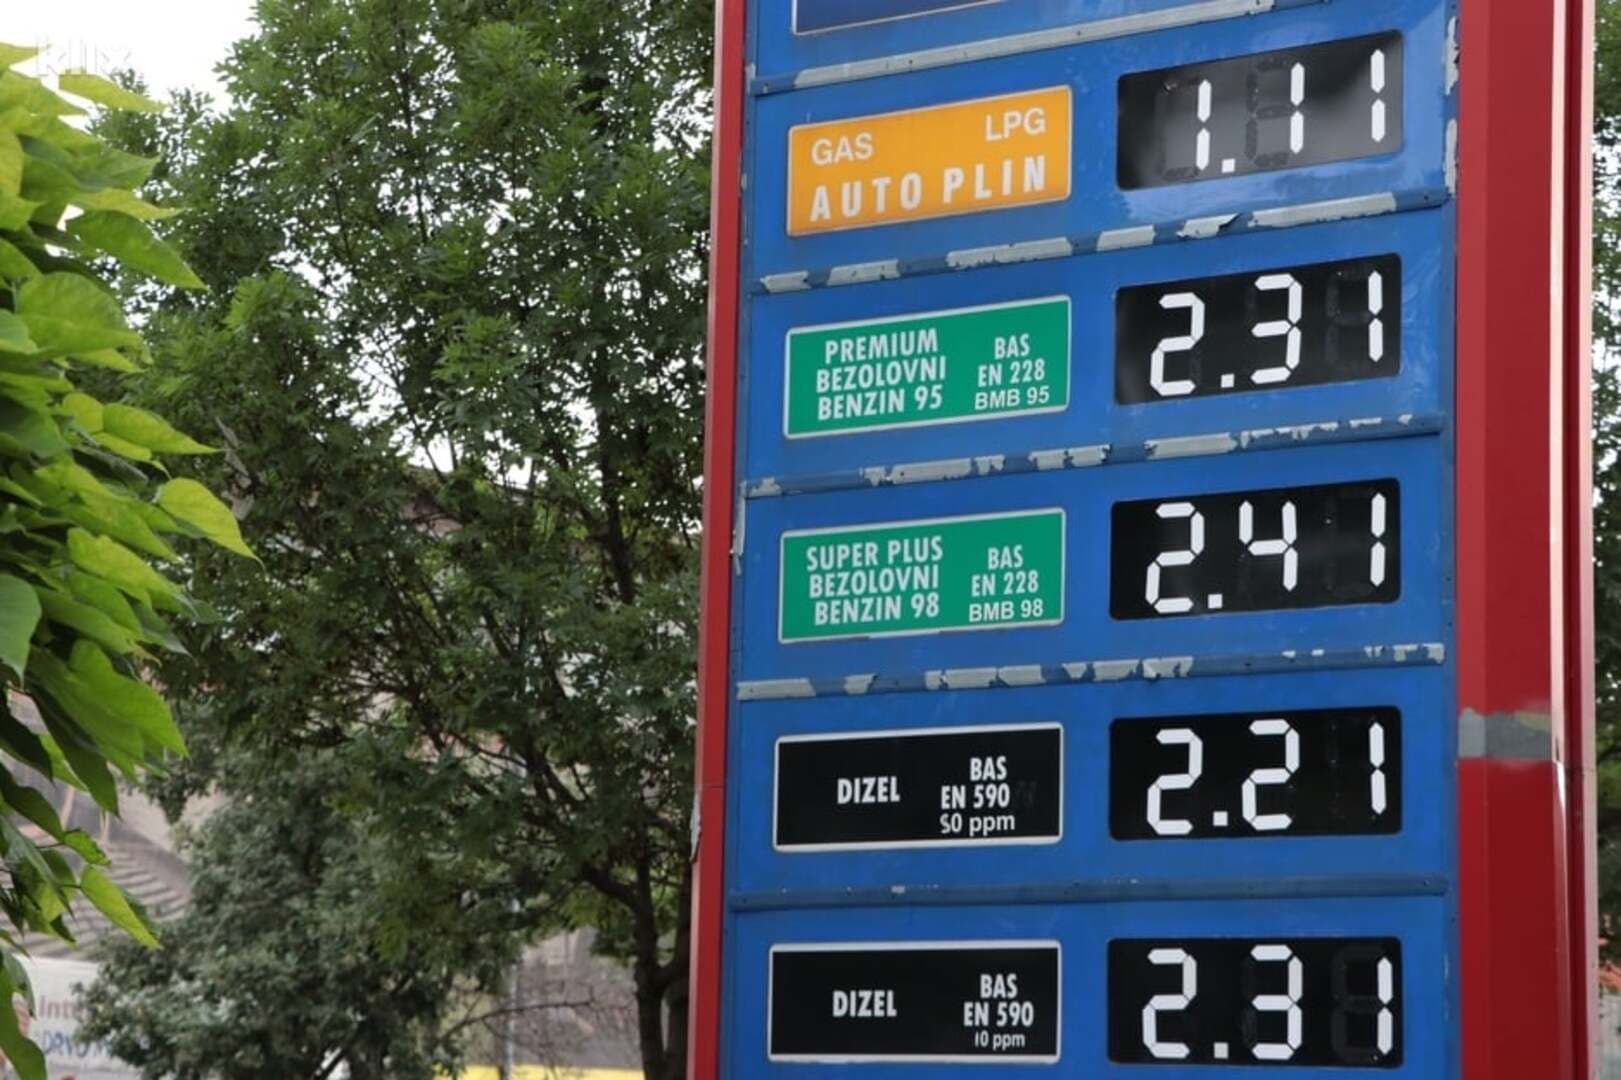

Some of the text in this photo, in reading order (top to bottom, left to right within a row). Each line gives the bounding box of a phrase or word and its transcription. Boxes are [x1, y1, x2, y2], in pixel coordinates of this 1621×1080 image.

[984, 107, 1046, 142] LPG
[1196, 49, 1386, 173] 1.11
[811, 132, 873, 165] GAS
[810, 155, 1046, 222] AUTO PLIN
[825, 328, 937, 364] PREMIUM
[994, 333, 1029, 360] BAS
[1150, 270, 1384, 397] 2.31
[816, 356, 946, 393] BEZOLOVNI
[977, 358, 1045, 387] EN 228
[818, 384, 943, 421] BENZIN 95
[974, 385, 1049, 411] BMB 95
[806, 535, 943, 572] SUPER PLUS
[988, 545, 1024, 570] BAS
[1145, 492, 1387, 614] 2.41
[809, 564, 939, 599] BEZOLOVNI
[971, 570, 1039, 597] EN 228
[814, 592, 940, 626] BENZIN 98
[968, 598, 1044, 622] BMB 98
[969, 756, 1008, 782] BAS
[1147, 719, 1387, 835] 2.21
[836, 776, 901, 804] DIZEL
[940, 783, 1010, 810] EN 590
[968, 814, 1016, 837] ppm
[980, 973, 1018, 999] BAS
[832, 990, 898, 1017] DIZEL
[963, 1001, 1035, 1027] EN 590
[1142, 944, 1393, 1060] 2.31
[974, 1030, 1026, 1051] 10 ppm
